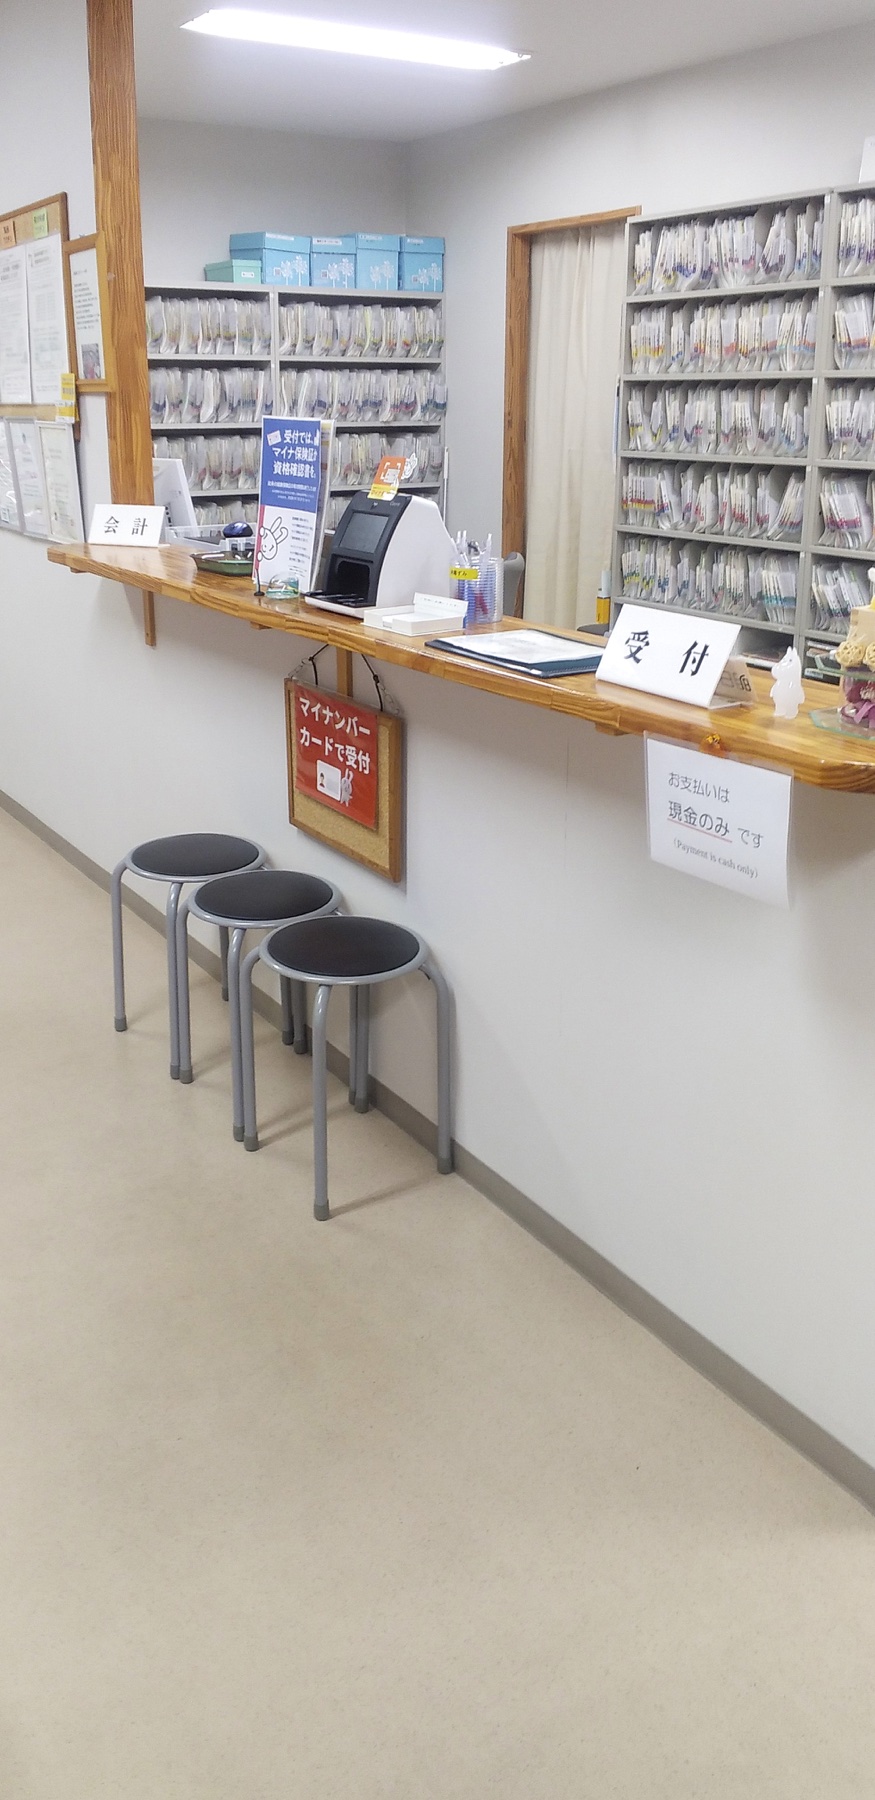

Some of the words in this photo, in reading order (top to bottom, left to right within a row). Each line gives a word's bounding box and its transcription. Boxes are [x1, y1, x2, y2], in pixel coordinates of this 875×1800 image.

[104, 515, 148, 536] 会計
[623, 629, 709, 677] 受付
[299, 697, 371, 737] マイナンバー
[300, 726, 371, 775] カードで受付
[668, 772, 730, 803] お支払いは
[668, 800, 730, 837] 現金のみ
[737, 827, 764, 849] です
[710, 852, 717, 862] is
[718, 857, 736, 869] cash
